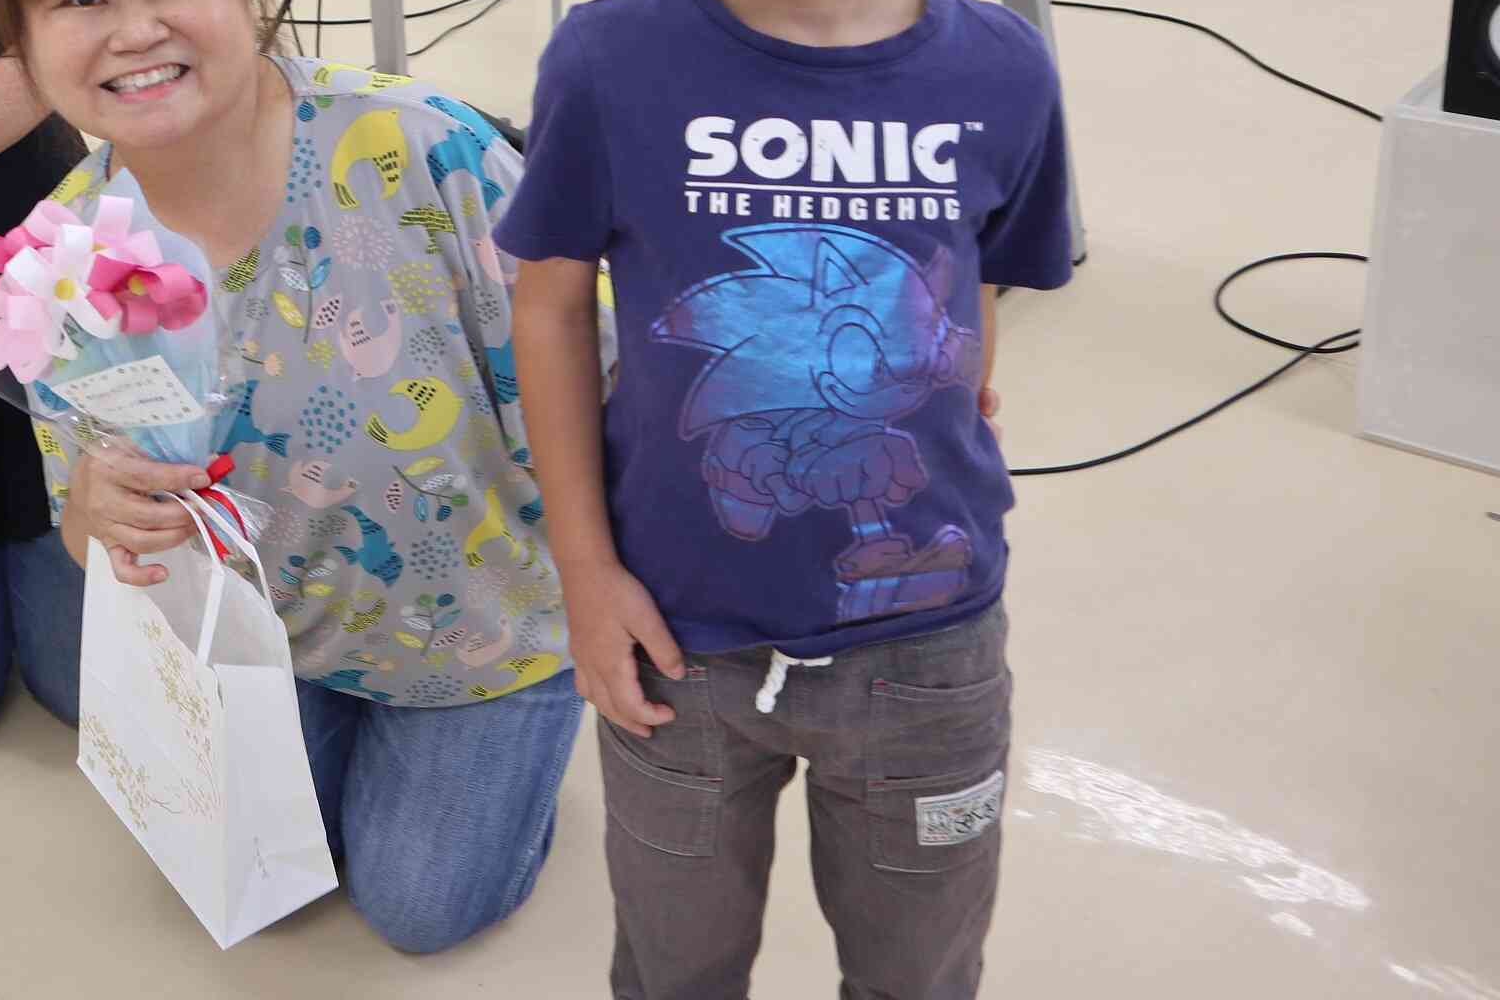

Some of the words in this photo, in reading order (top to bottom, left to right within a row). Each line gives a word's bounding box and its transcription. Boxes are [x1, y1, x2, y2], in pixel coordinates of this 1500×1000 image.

[684, 115, 962, 184] SONIC
[684, 190, 752, 216] THE
[772, 193, 962, 222] HEDGEHOG
